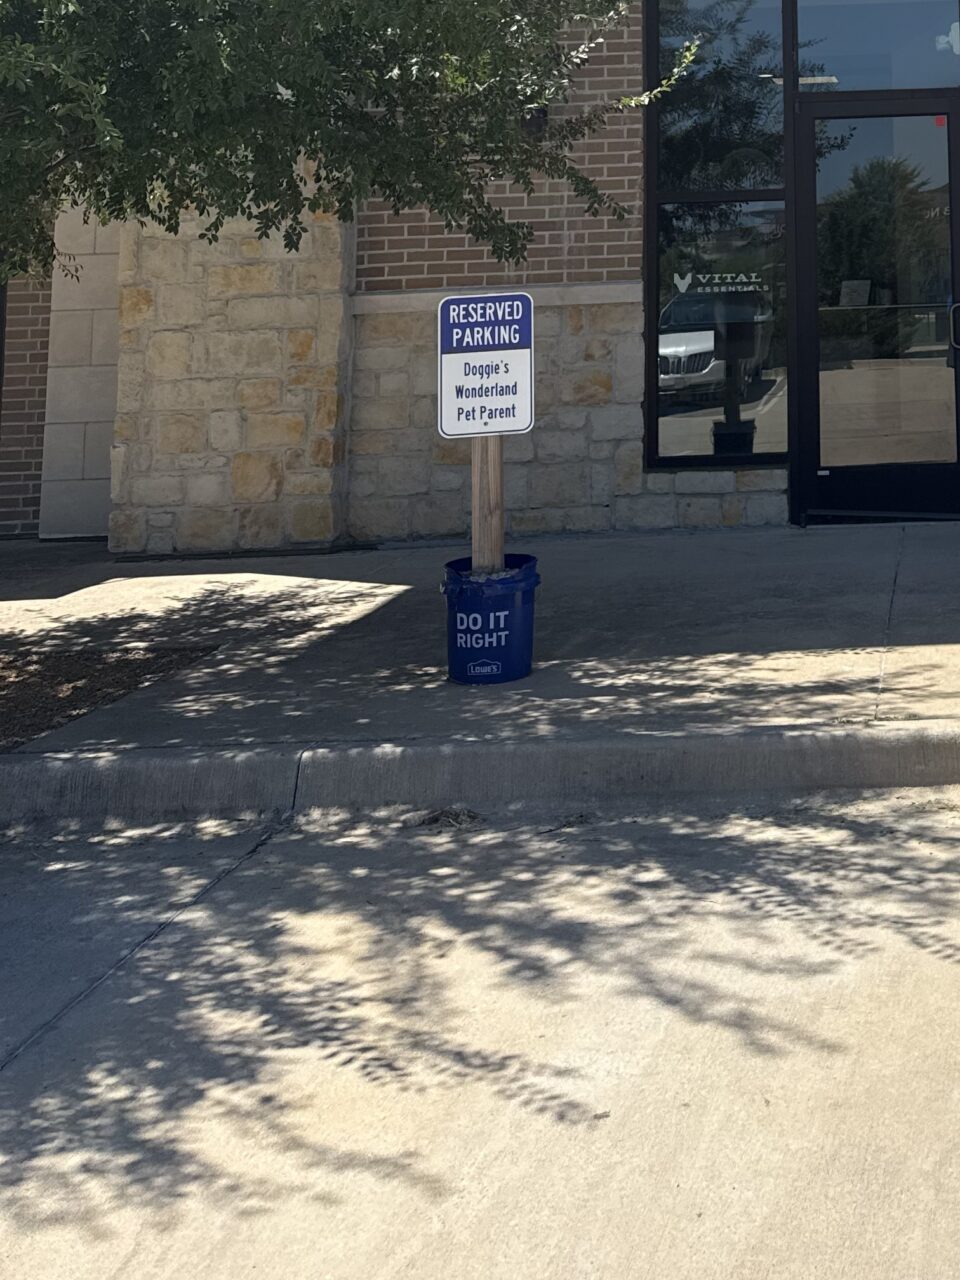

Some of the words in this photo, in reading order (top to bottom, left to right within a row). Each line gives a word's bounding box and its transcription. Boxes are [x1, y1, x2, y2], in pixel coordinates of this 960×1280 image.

[696, 273, 762, 283] VITAL
[449, 301, 523, 324] RESERVED
[452, 324, 520, 348] PARKING
[464, 360, 510, 380] Doggie's
[455, 381, 518, 400] Wonderland
[457, 406, 476, 422] Pet
[480, 403, 516, 420] Parent
[456, 612, 482, 631] DO
[489, 610, 509, 630] IT
[456, 631, 510, 648] RIGHT
[470, 664, 498, 673] LOWE'S
